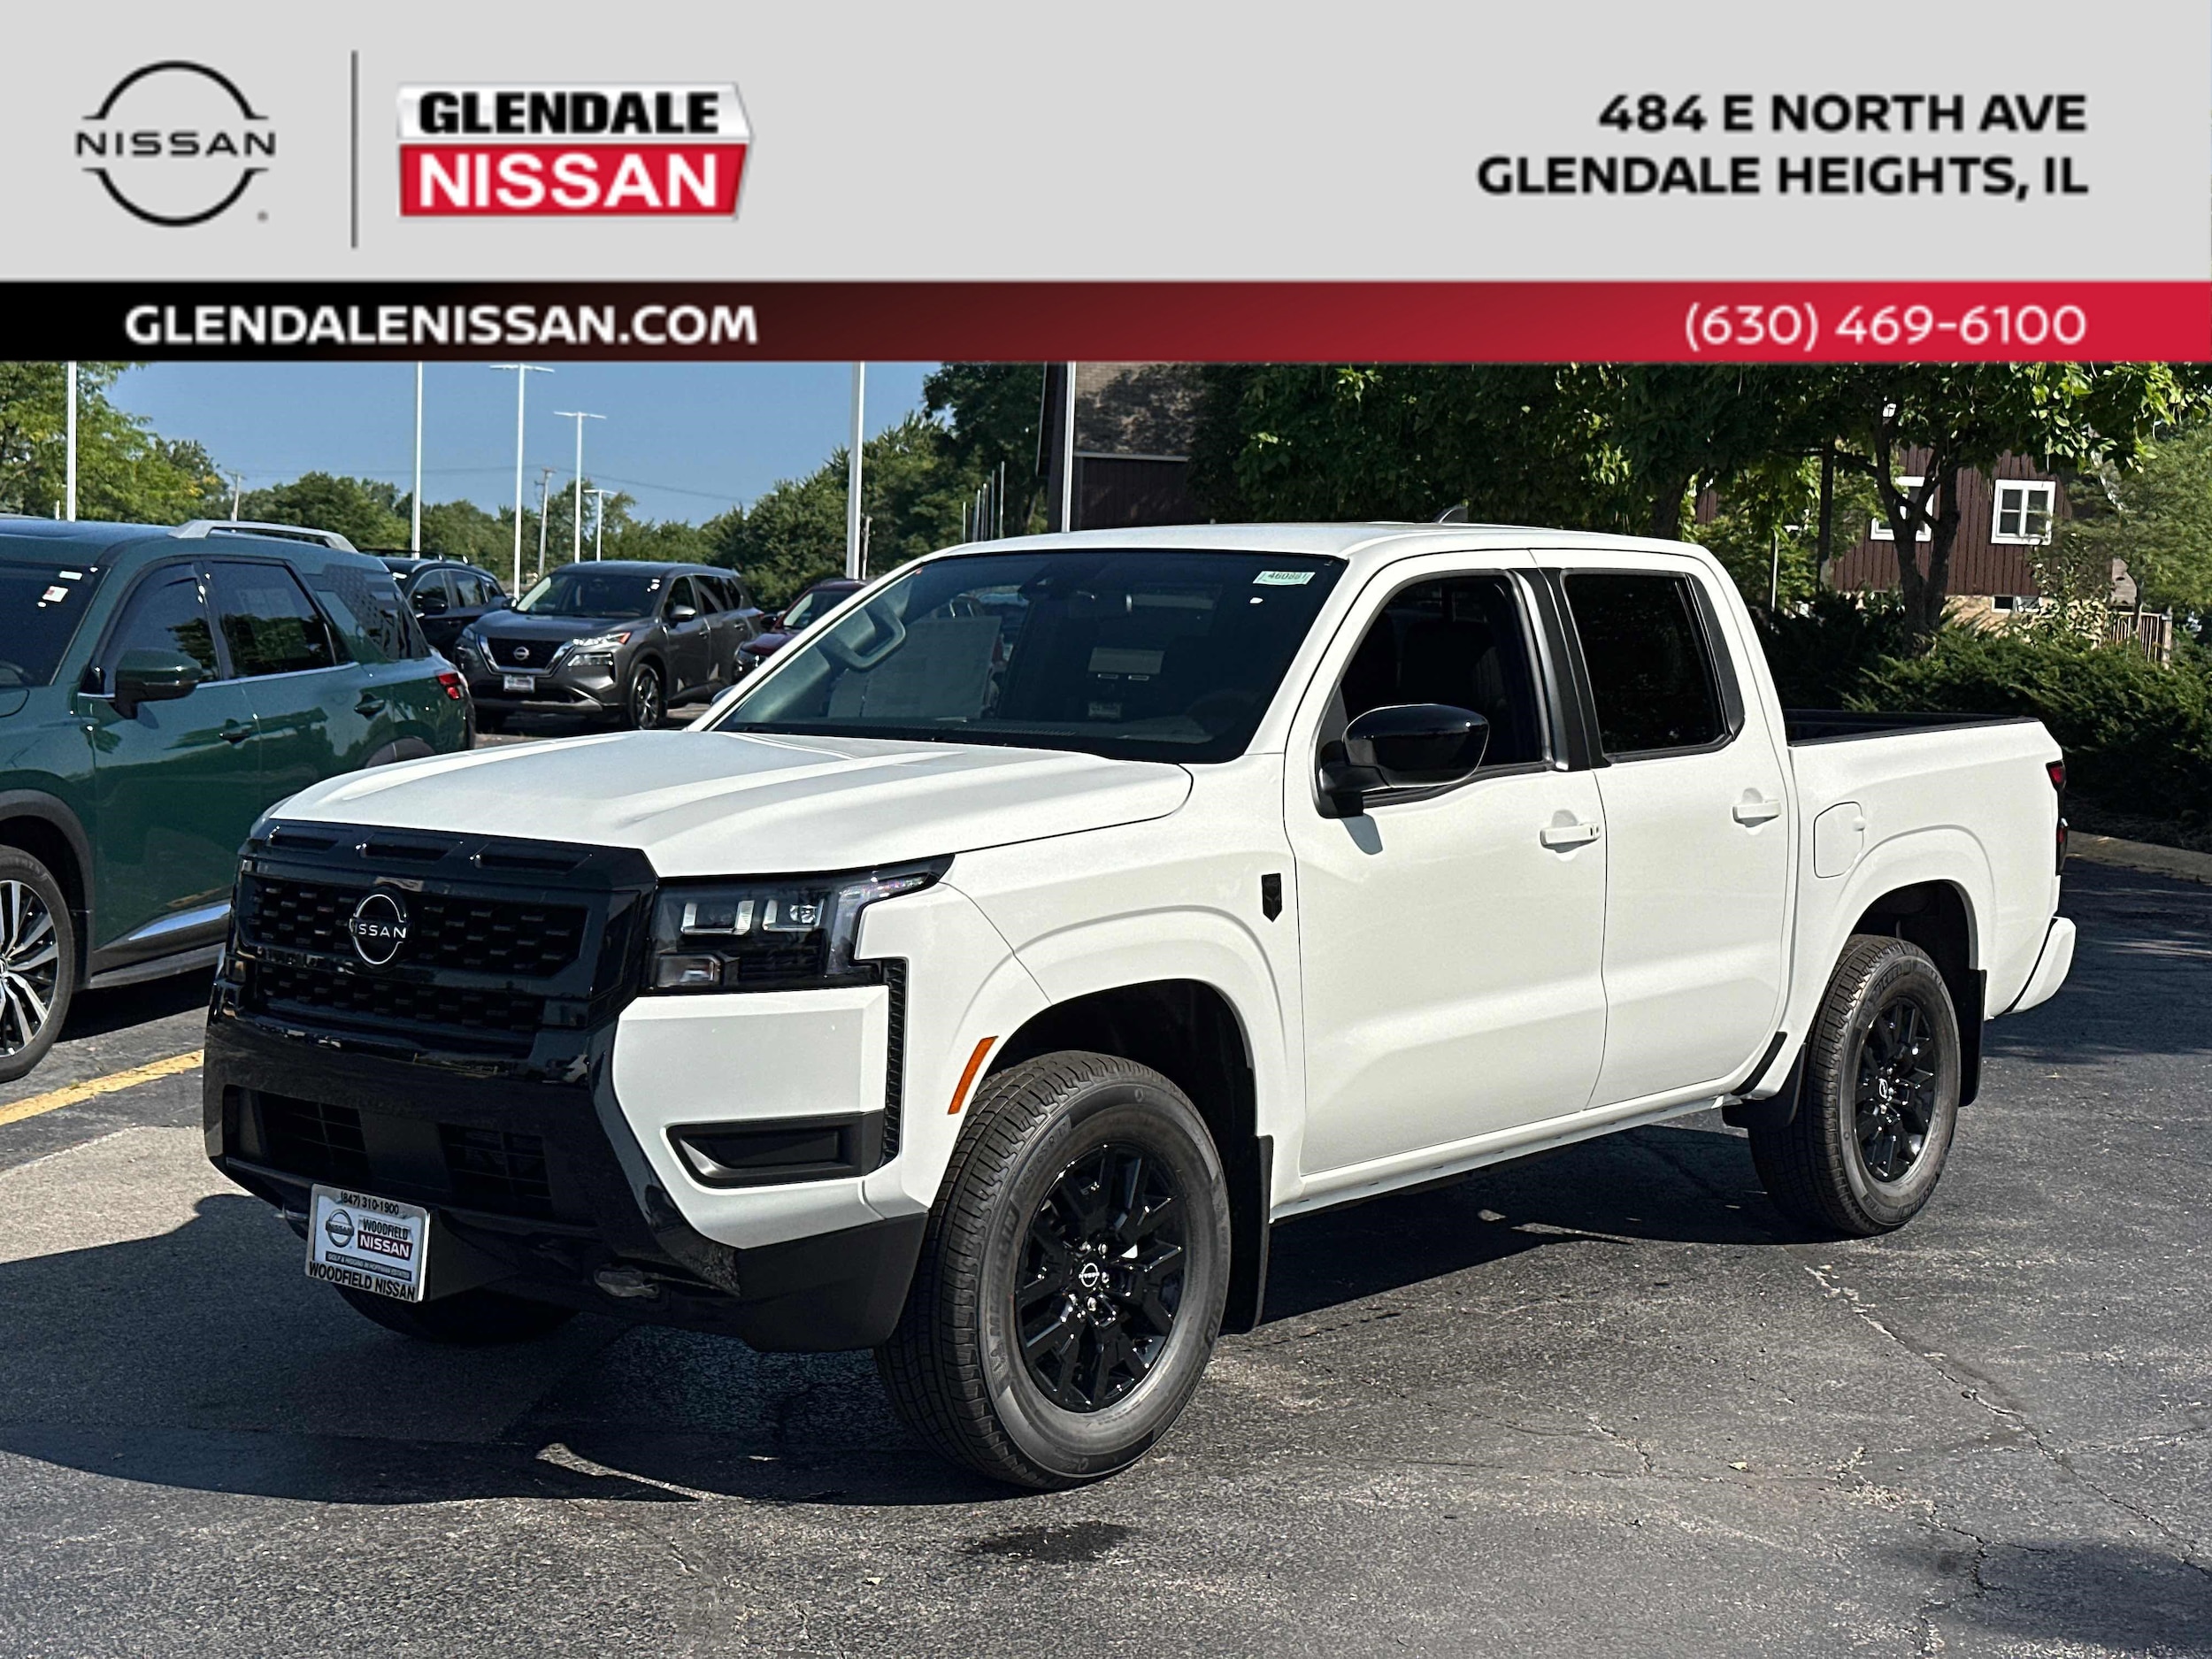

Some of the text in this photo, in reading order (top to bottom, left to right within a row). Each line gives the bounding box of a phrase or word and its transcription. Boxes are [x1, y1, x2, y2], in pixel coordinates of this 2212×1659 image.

[341, 1191, 399, 1215] (847) 310-1900
[363, 1218, 409, 1240] WOODFIELD
[360, 1234, 410, 1257] NISSAN
[310, 1262, 416, 1302] WOODFIELD NISSAN
